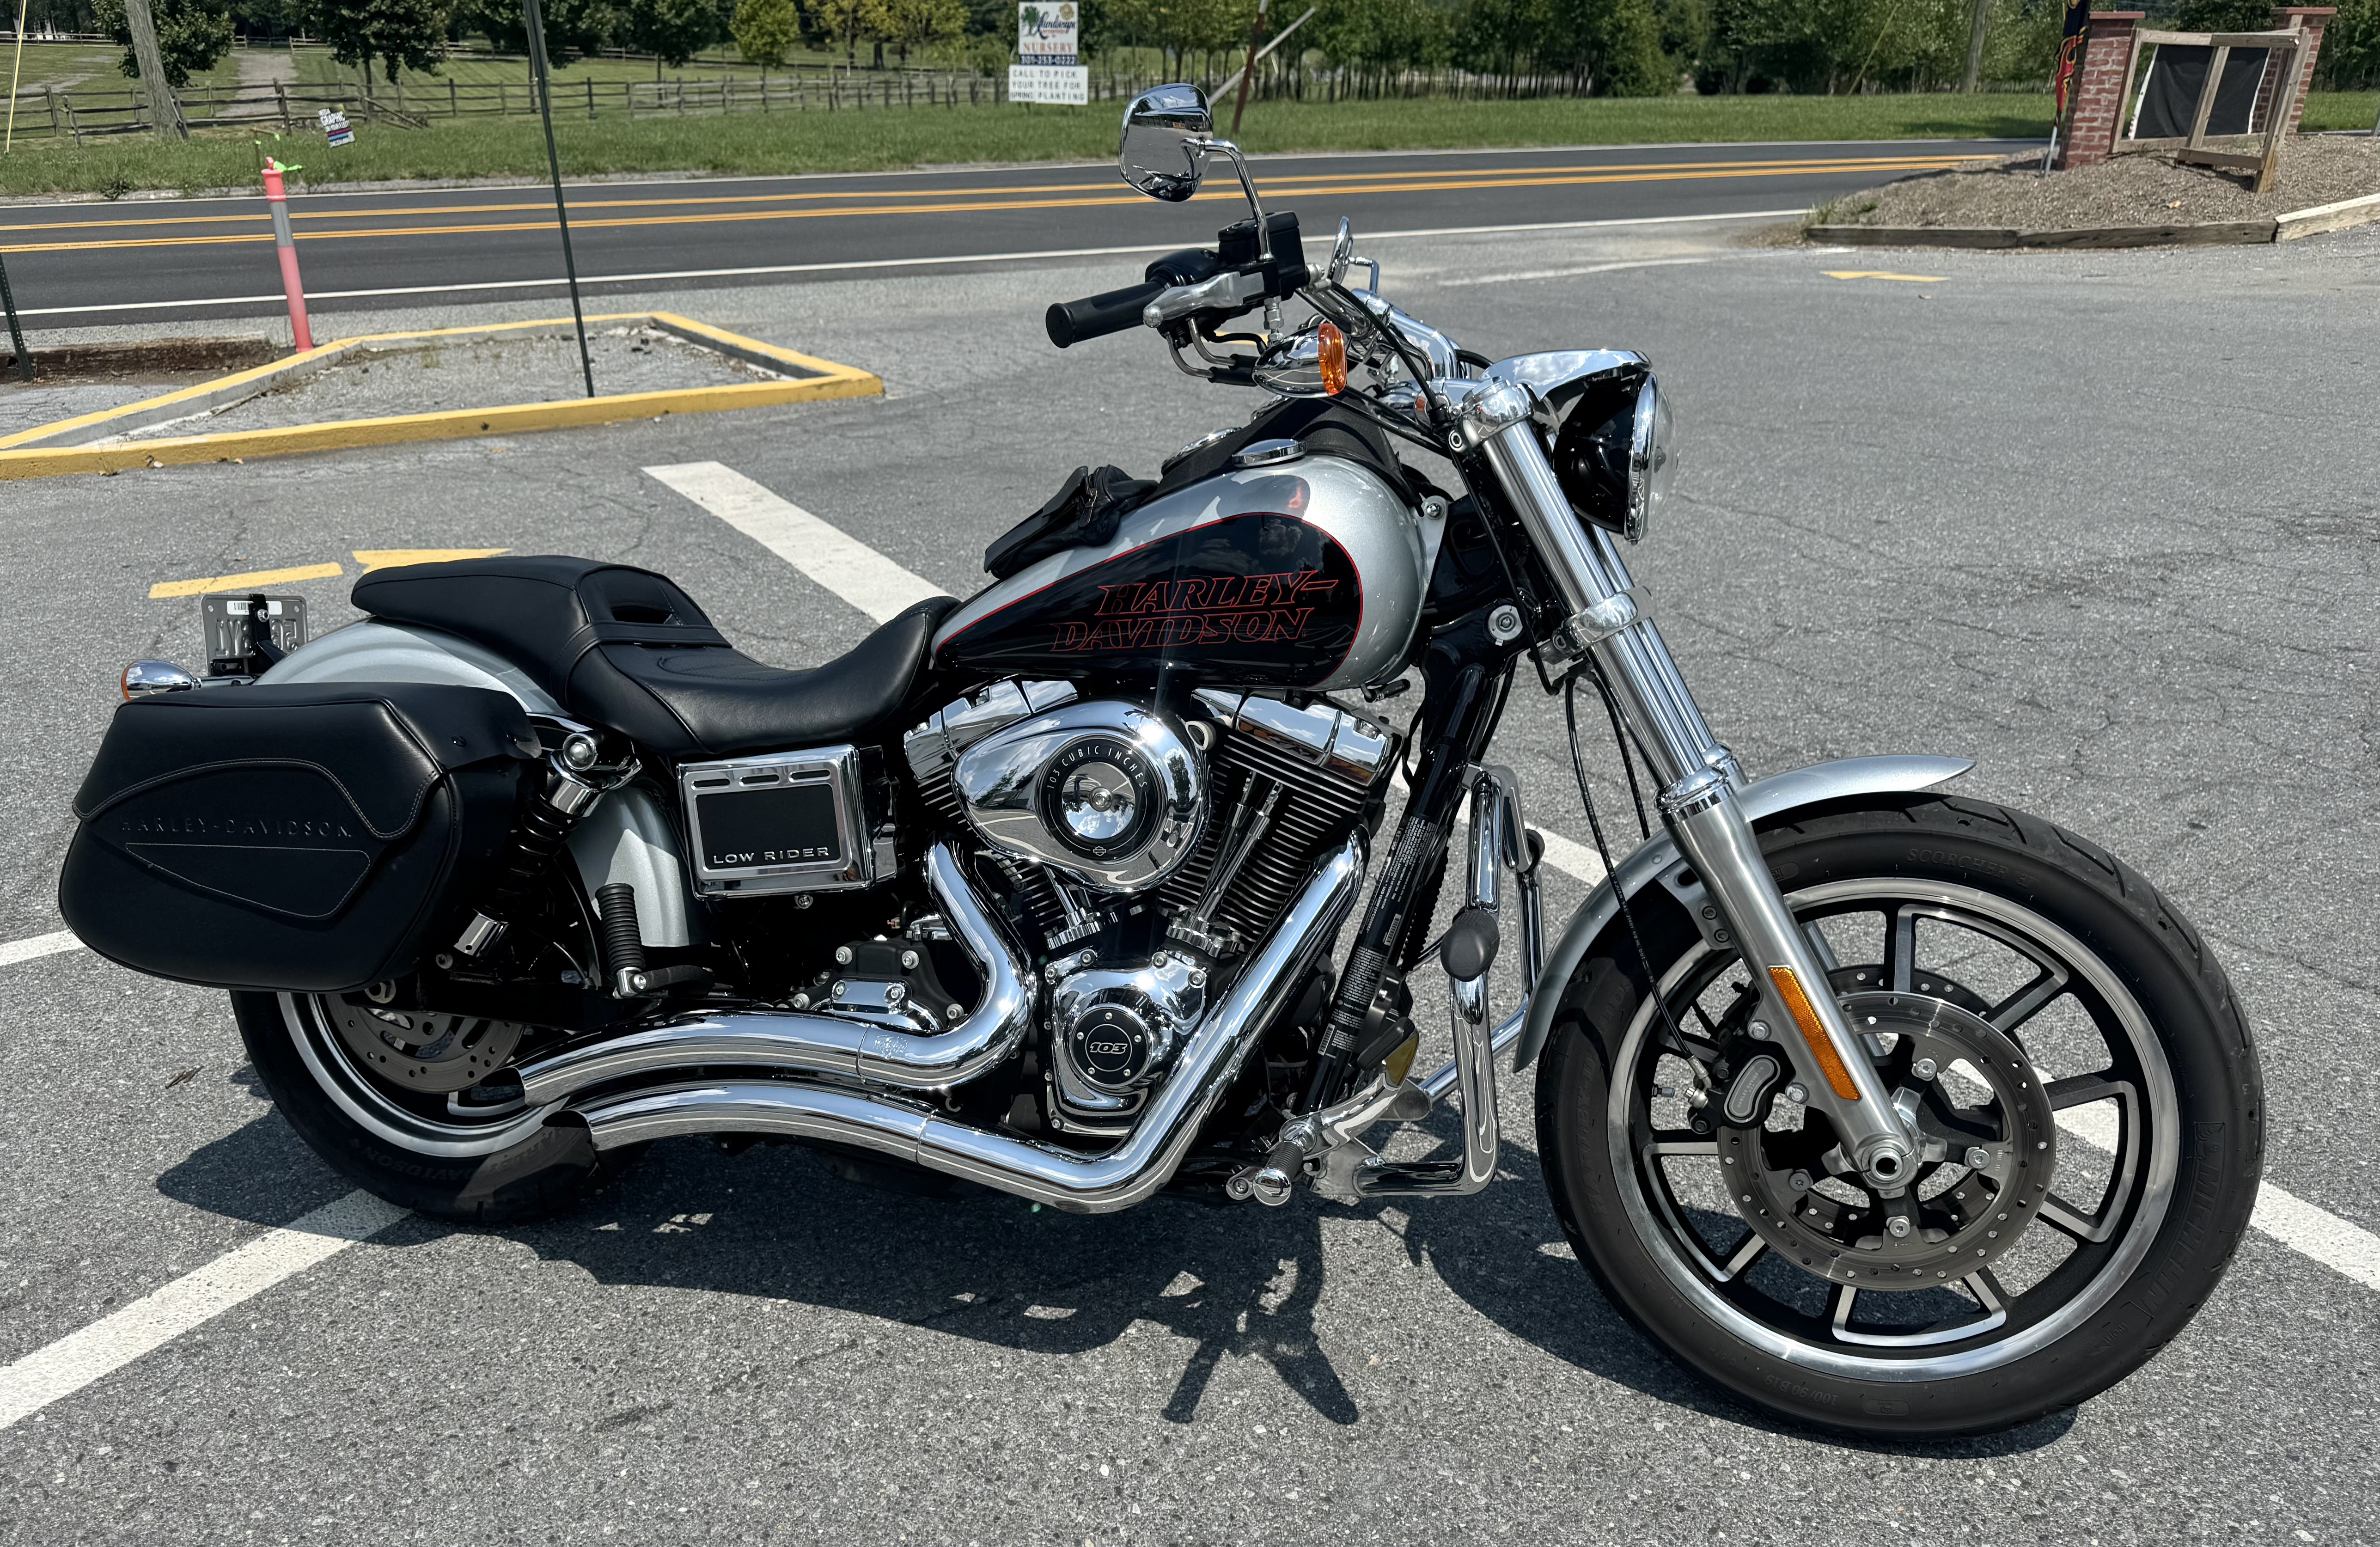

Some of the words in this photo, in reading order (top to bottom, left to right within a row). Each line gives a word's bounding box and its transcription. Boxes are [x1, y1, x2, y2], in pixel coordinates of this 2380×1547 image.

[1023, 43, 1073, 54] NURSERY
[1038, 93, 1085, 101] PLANTING
[1095, 570, 1339, 616] HARLEY-
[1050, 607, 1314, 652] DAVIDSON
[1047, 769, 1061, 789] 103
[1062, 746, 1099, 767] CUBIC
[1108, 747, 1147, 788] INCHES
[713, 852, 755, 864] LOW
[764, 847, 830, 861] RIDER
[1090, 1041, 1128, 1055] 103
[1791, 1387, 1839, 1407] 100/90
